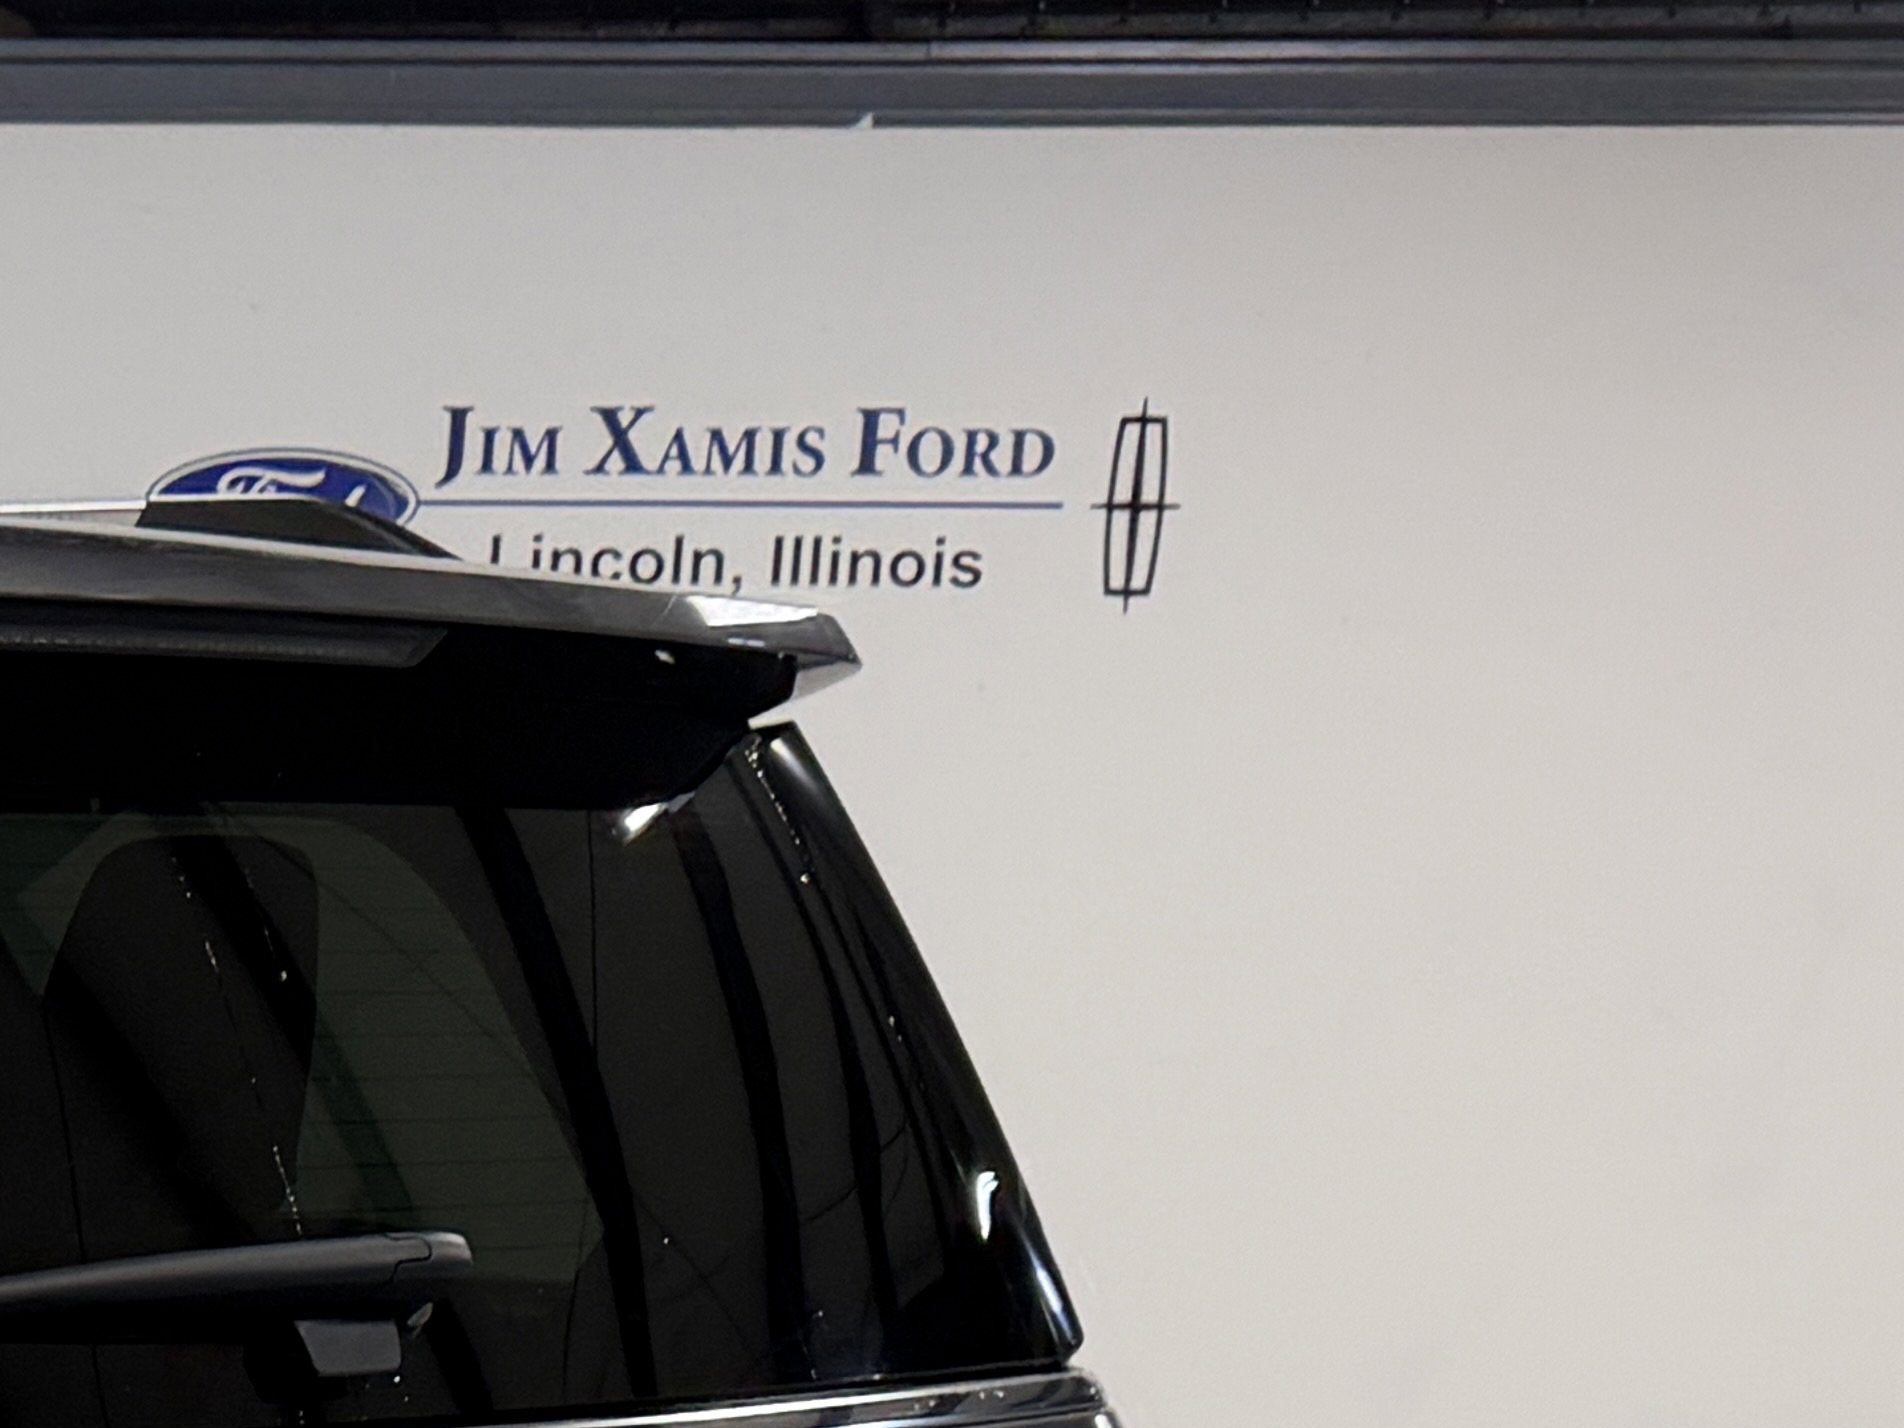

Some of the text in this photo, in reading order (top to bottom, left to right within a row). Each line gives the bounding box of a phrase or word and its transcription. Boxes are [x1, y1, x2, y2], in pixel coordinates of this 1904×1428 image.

[435, 405, 564, 489] JIM
[582, 405, 826, 479] XAMIS
[850, 406, 1057, 480] FORD
[769, 534, 985, 589] Illinois
